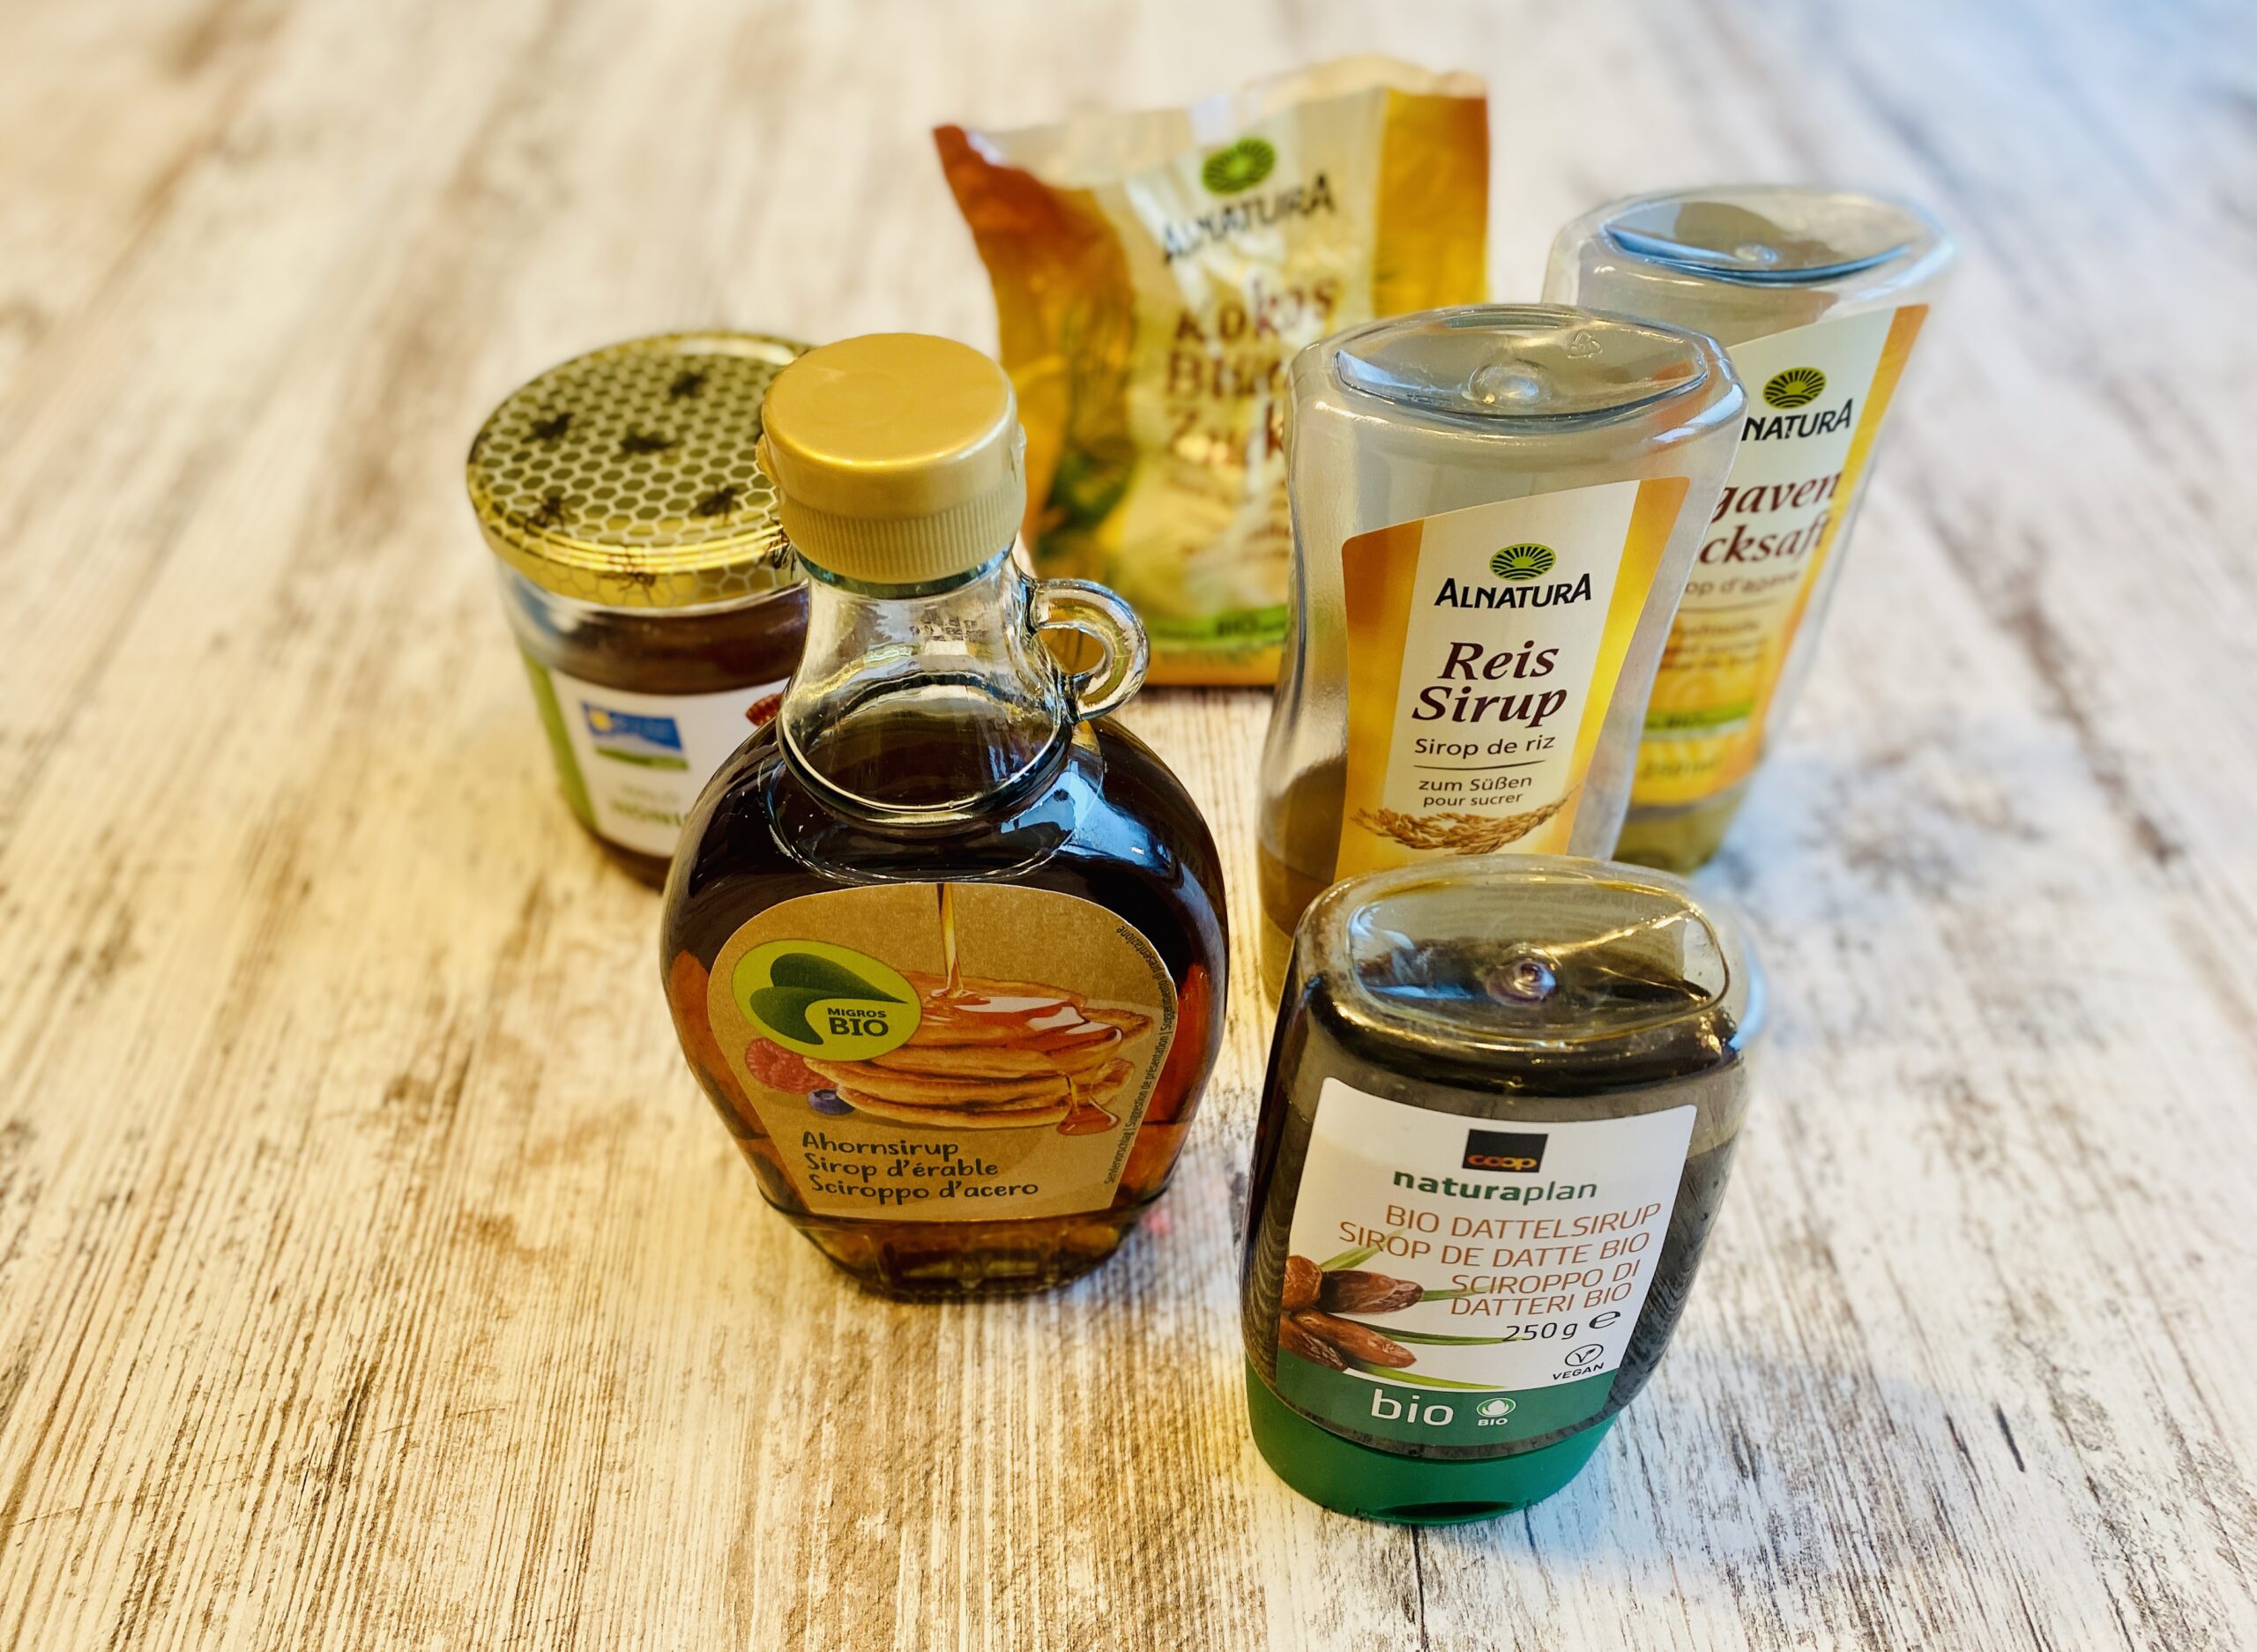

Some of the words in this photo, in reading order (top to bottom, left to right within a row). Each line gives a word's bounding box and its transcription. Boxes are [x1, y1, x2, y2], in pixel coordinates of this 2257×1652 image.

[1740, 398, 1853, 442] NATURA
[1710, 472, 1842, 525] gaven
[1698, 510, 1834, 566] cksaft
[1434, 573, 1591, 609] ALNATURA
[1437, 640, 1560, 681] Reis
[1412, 686, 1568, 729] Sirup
[1414, 738, 1479, 759] Sirop
[1487, 739, 1517, 755] de
[1525, 734, 1556, 752] riz
[1419, 779, 1463, 791] zum
[1470, 777, 1532, 792] Süßen
[1423, 796, 1465, 807] pour
[1470, 793, 1523, 807] sucrer
[1116, 926, 1163, 975] presentazione
[827, 1008, 887, 1018] MIGROS
[829, 1017, 889, 1037] BIO
[1145, 1036, 1168, 1083] présentation
[1141, 1080, 1152, 1090] de
[1126, 1089, 1148, 1128] Suggestion
[802, 1131, 959, 1161] Ahornsirup
[1104, 1131, 1135, 1185] Serviervorschlag
[1467, 1153, 1538, 1171] coop
[804, 1152, 877, 1182] Sirop
[887, 1158, 998, 1177] d'érable
[808, 1173, 930, 1205] Sciroppo
[939, 1179, 1039, 1198] d'acero
[1393, 1171, 1598, 1205] naturaplan
[1385, 1204, 1439, 1232] BIO
[1451, 1202, 1661, 1239] DATTELSIRUP
[1339, 1221, 1431, 1259] SIROP
[1441, 1245, 1484, 1267] DE
[1492, 1244, 1591, 1268] DATTE
[1599, 1232, 1650, 1260] BIO
[1451, 1268, 1604, 1294] SCIROPPO
[1613, 1260, 1641, 1282] DI
[1451, 1294, 1574, 1316] DATTERI
[1583, 1283, 1632, 1309] BIO
[1553, 1362, 1605, 1380] VEGAN
[1371, 1388, 1454, 1426] bio
[1478, 1418, 1508, 1426] BIO
